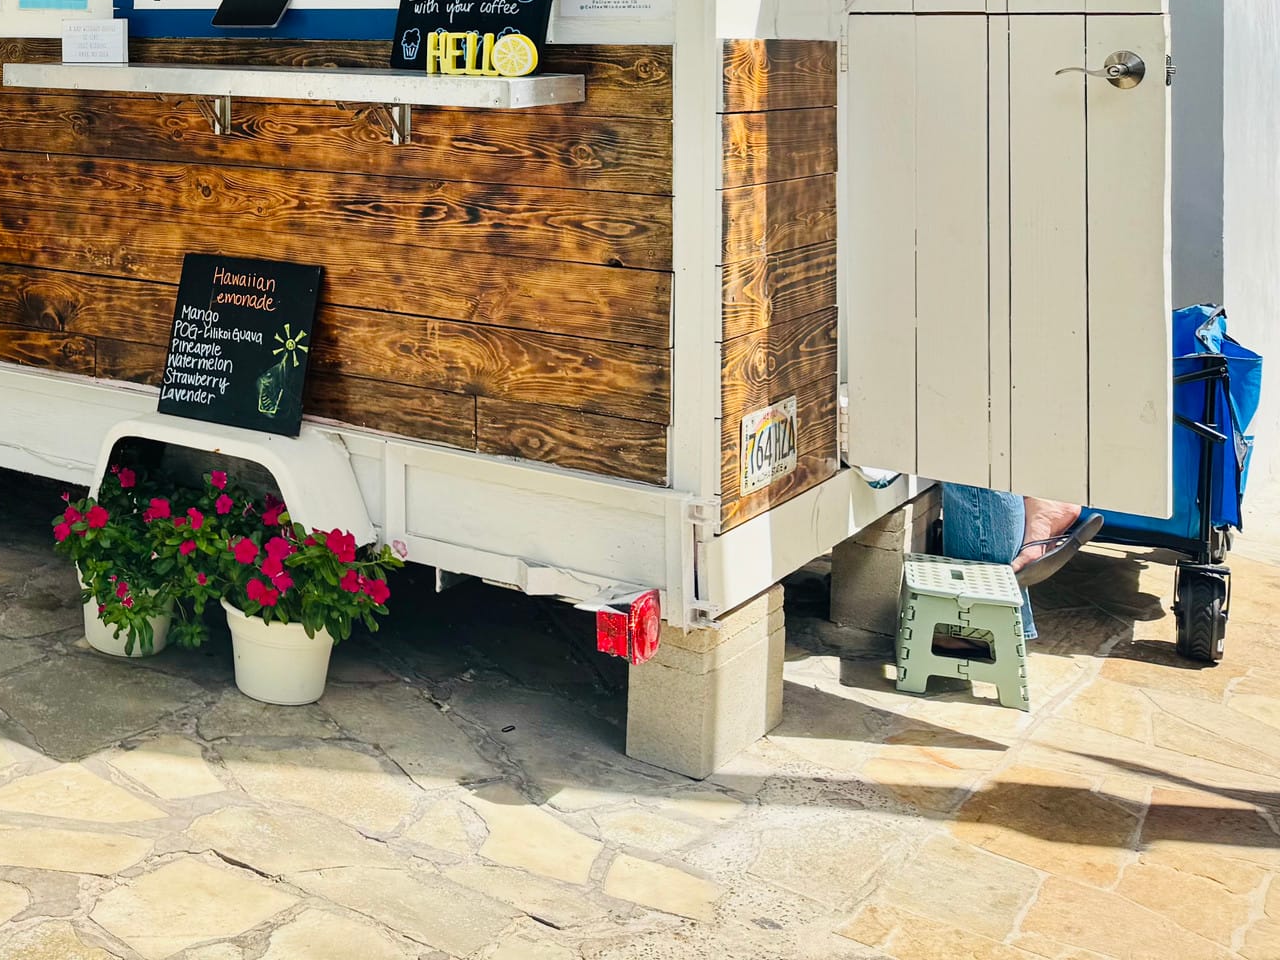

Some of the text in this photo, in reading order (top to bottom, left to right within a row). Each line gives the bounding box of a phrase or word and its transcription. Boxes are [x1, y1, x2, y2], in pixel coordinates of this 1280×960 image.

[446, 1, 475, 24] your
[479, 0, 520, 15] coffee
[427, 31, 539, 77] HELLO
[213, 266, 276, 292] Hawaiian
[181, 304, 219, 328] Mango
[171, 338, 222, 357] Pineapple
[232, 327, 263, 345] Guava
[167, 353, 233, 374] Watermelon
[163, 367, 230, 394] Strawberry
[161, 386, 216, 405] Lavender
